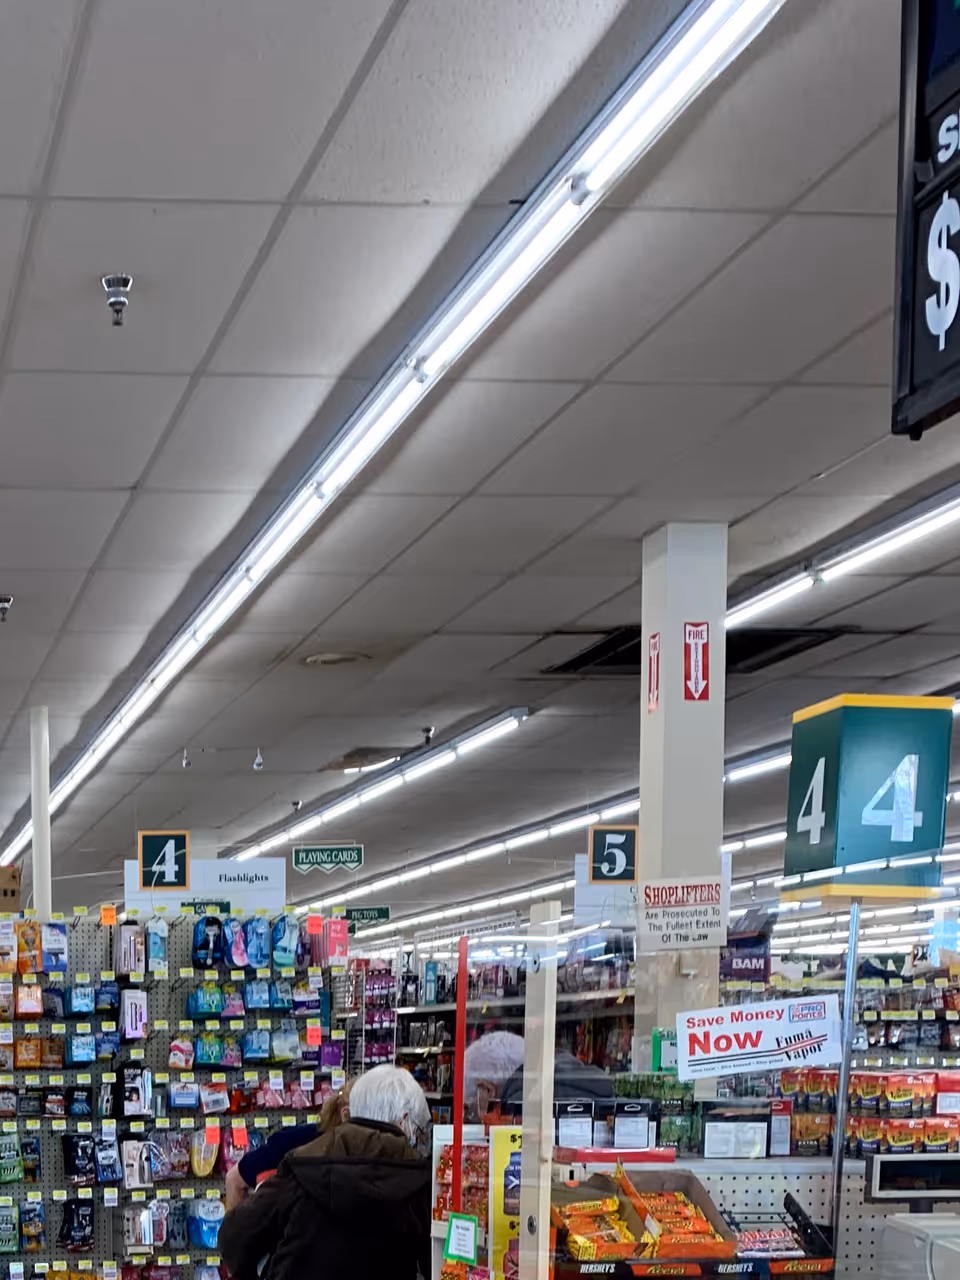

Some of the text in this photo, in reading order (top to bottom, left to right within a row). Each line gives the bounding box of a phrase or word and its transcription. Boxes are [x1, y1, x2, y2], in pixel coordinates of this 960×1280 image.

[688, 629, 705, 641] FIRE
[797, 757, 826, 845] 4
[861, 754, 923, 842] 4
[151, 839, 180, 883] 4
[298, 849, 358, 863] PLAYING CARDS
[600, 833, 627, 877] 5
[218, 872, 269, 883] Flashlights
[644, 883, 721, 905] SHOPLIFTERS
[363, 910, 379, 918] TOYS
[645, 907, 720, 920] Are Prosecuted To
[648, 919, 721, 932] The Fullest Extent
[661, 933, 709, 943] Of The aw
[732, 957, 765, 970] BAM
[686, 1008, 785, 1030] Save Money
[688, 1029, 763, 1057] Now
[785, 1041, 824, 1061] Vapor
[580, 1263, 615, 1273] HERSHEY'S
[645, 1264, 685, 1275] Reese's
[718, 1262, 753, 1273] HERSHEY'S
[783, 1261, 823, 1272] Reese's
